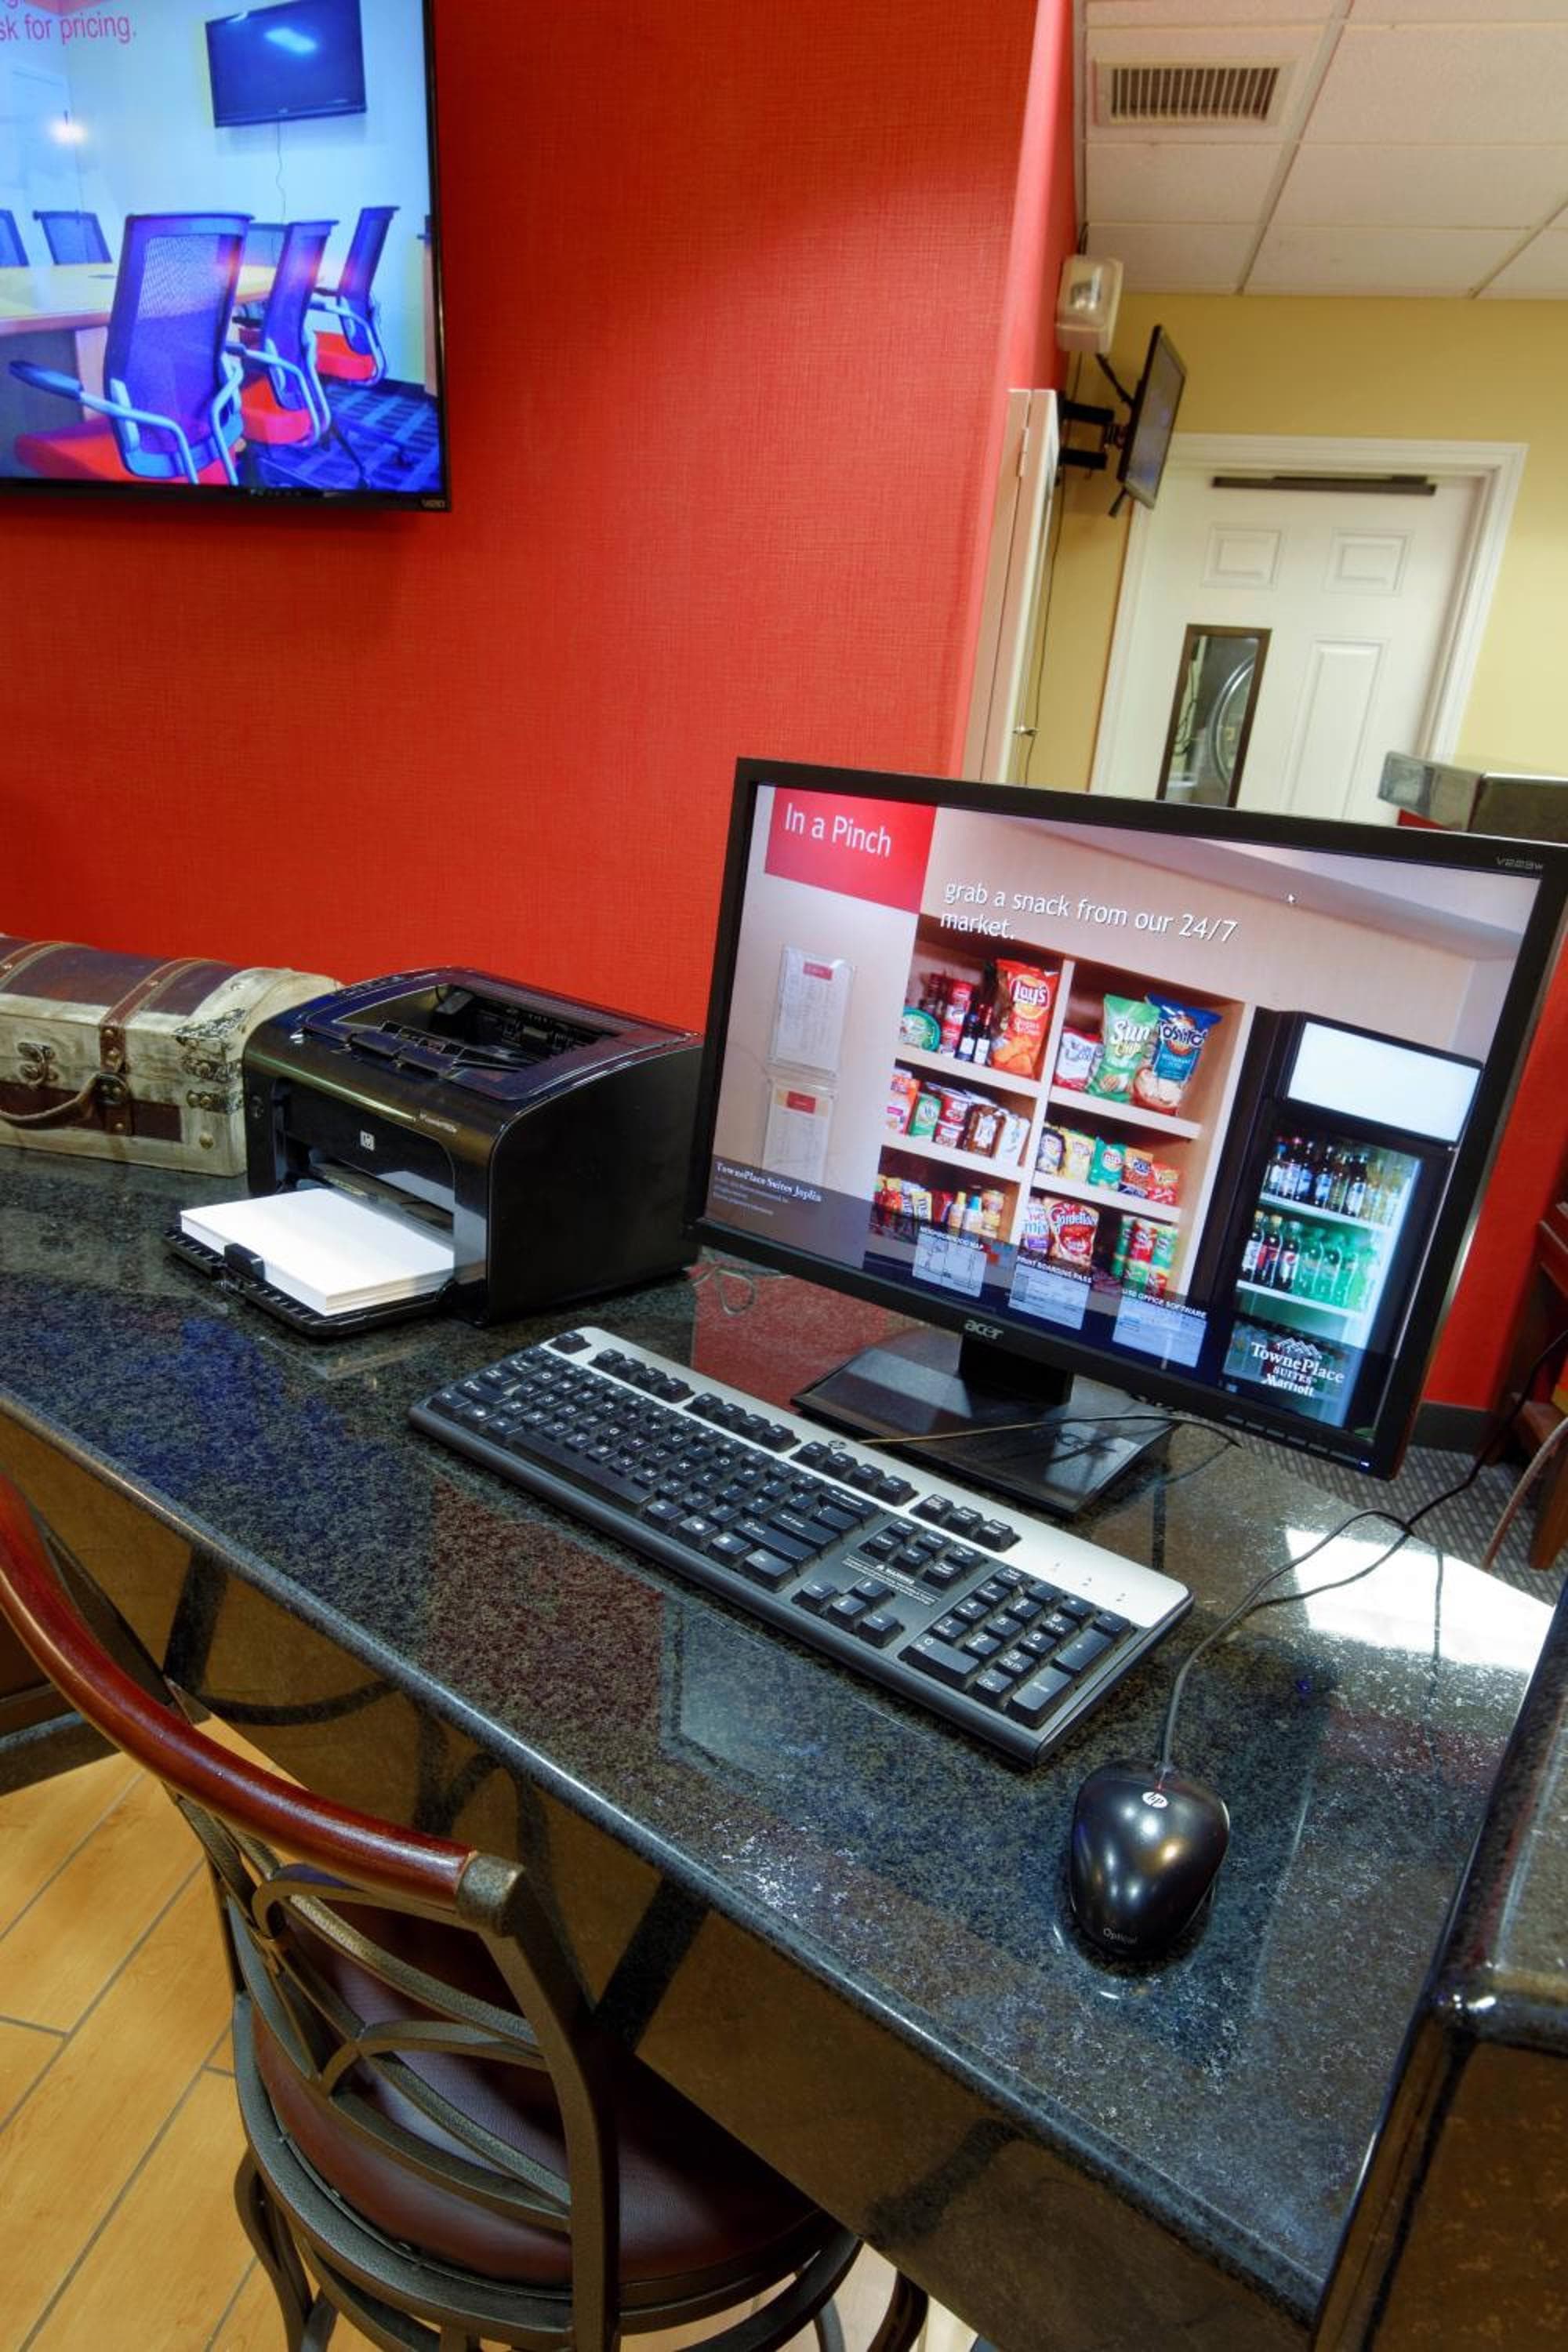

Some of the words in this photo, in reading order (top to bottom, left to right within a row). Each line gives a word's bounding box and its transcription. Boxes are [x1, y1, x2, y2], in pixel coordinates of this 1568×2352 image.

[25, 14, 52, 39] for
[60, 12, 136, 45] pricing.
[786, 803, 805, 834] In
[811, 818, 825, 840] a
[832, 815, 892, 857] Pinch
[940, 912, 1015, 940] market.
[944, 880, 988, 905] grab
[994, 890, 1006, 908] a
[1014, 891, 1070, 917] snack
[1077, 898, 1128, 927] from
[1134, 912, 1173, 932] our
[1178, 913, 1238, 942] 24/7
[963, 1319, 1004, 1341] acer
[1250, 1341, 1345, 1384] TownePlace
